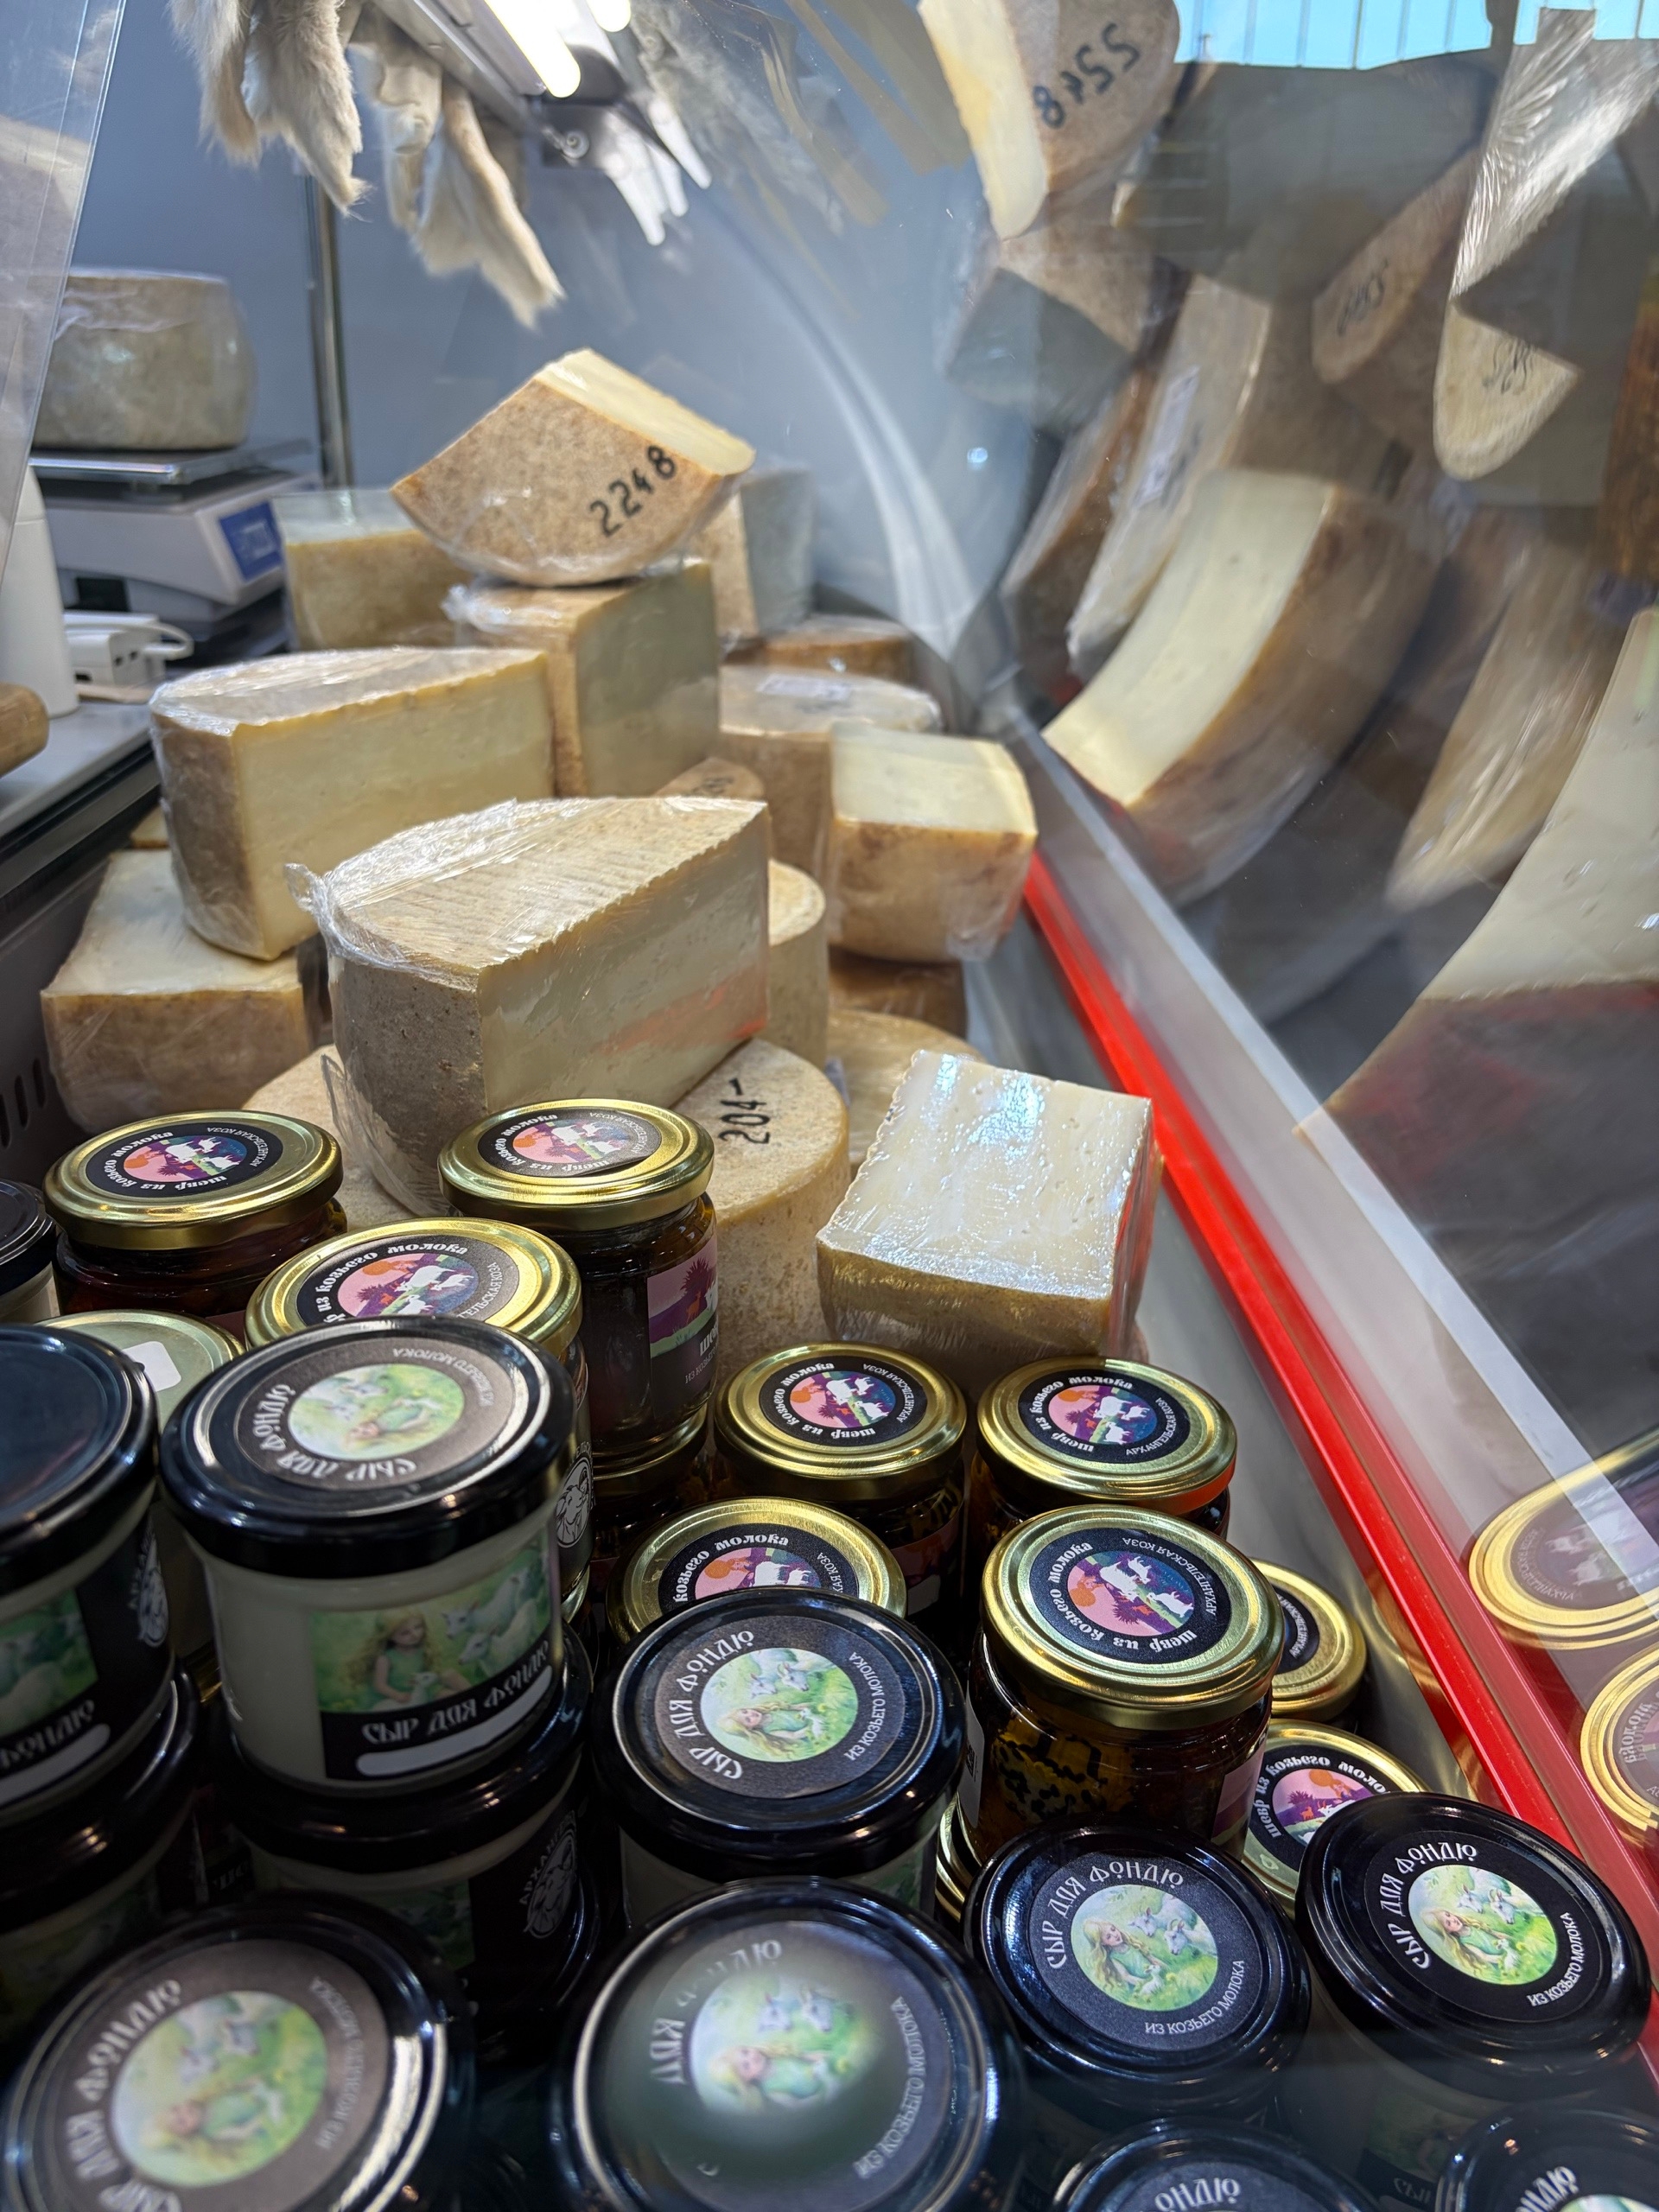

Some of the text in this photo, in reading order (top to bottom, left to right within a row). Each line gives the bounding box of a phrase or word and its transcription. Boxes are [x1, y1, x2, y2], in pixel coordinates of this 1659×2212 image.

[589, 445, 677, 537] 2248
[103, 1130, 228, 1192] шевр из козьего молока
[494, 1137, 526, 1166] козьего
[500, 1113, 558, 1137] молока
[315, 1243, 470, 1313] из козьего молока
[456, 1262, 504, 1319] ГЕЛЬСКАЯ КОЗА
[773, 1362, 876, 1440] шевр из козьего молока
[862, 1363, 916, 1423] АРХАНГЕЛЬСКАЯ КОЗА
[1029, 1376, 1135, 1453] шевр из козьего молока
[251, 1383, 417, 1482] СЫР ДЛЯ ФОНДЮ
[1125, 1414, 1177, 1456] АРХАНГЕЛЬСКАЯ
[672, 1533, 790, 1603] козьего молока
[817, 1552, 838, 1575] КОЗА
[1047, 1541, 1198, 1654] шевр из козьего молока
[1122, 1536, 1218, 1616] АРХАНГЕЛЬСКАЯ КОЗА
[361, 1639, 550, 1745] СЫР ДЛЯ ФОНДЮ
[669, 1630, 755, 1780] СЫР ДЛЯ ФОНДЮ
[843, 1651, 887, 1762] ИЗ КОЗЬЕГО МОЛОКА
[1253, 1755, 1390, 1839] шевр из козьего моло
[1041, 1859, 1184, 1970] СЫР ДЛЯ ФОНДЮ
[1379, 1841, 1478, 1970] СЫР ДЛЯ ФОНДЮ
[1144, 1959, 1245, 2035] ИЗ КОЗЬЕГО МОЛОКА
[1526, 1911, 1586, 2007] ИЗ КОЗЬЕГО МОЛОКА
[889, 1995, 927, 2075] МОЛОКА
[1154, 2177, 1241, 2212] ОНДЮ
[1516, 2165, 1580, 2212] НДЮ
